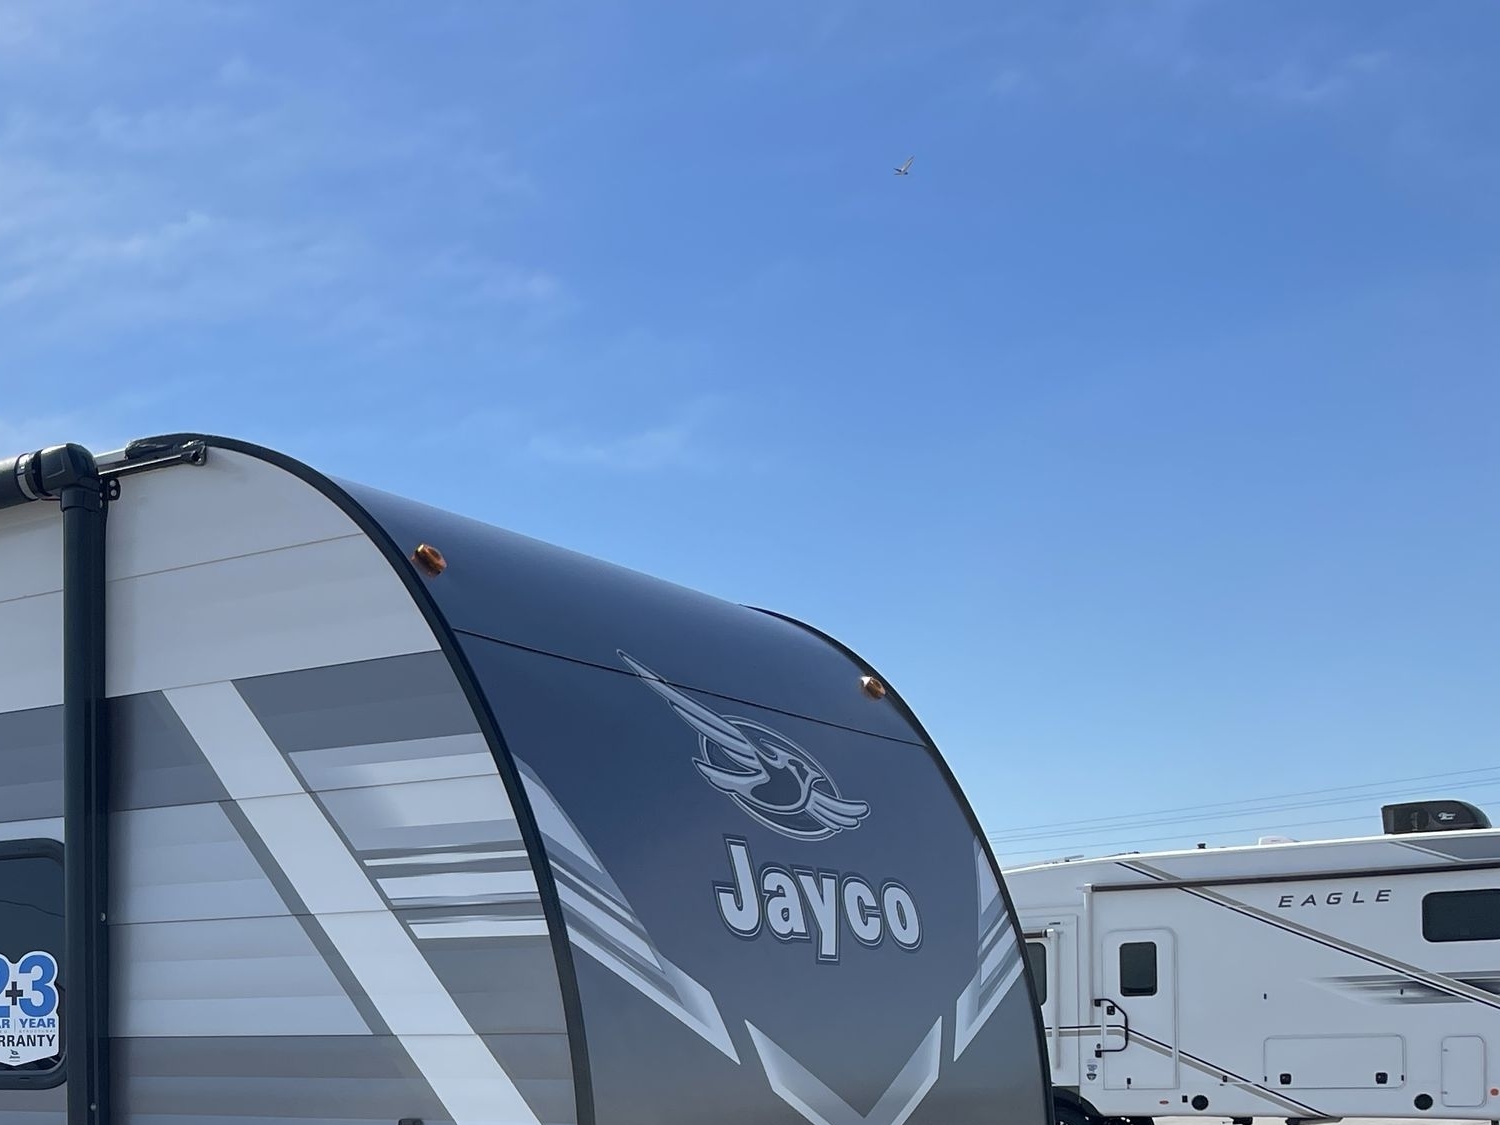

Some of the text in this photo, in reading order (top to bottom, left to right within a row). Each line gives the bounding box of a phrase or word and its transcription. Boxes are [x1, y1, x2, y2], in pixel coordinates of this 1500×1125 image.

[713, 835, 924, 963] Jayco
[1278, 889, 1392, 908] EAGLE
[19, 1018, 56, 1028] YEAR
